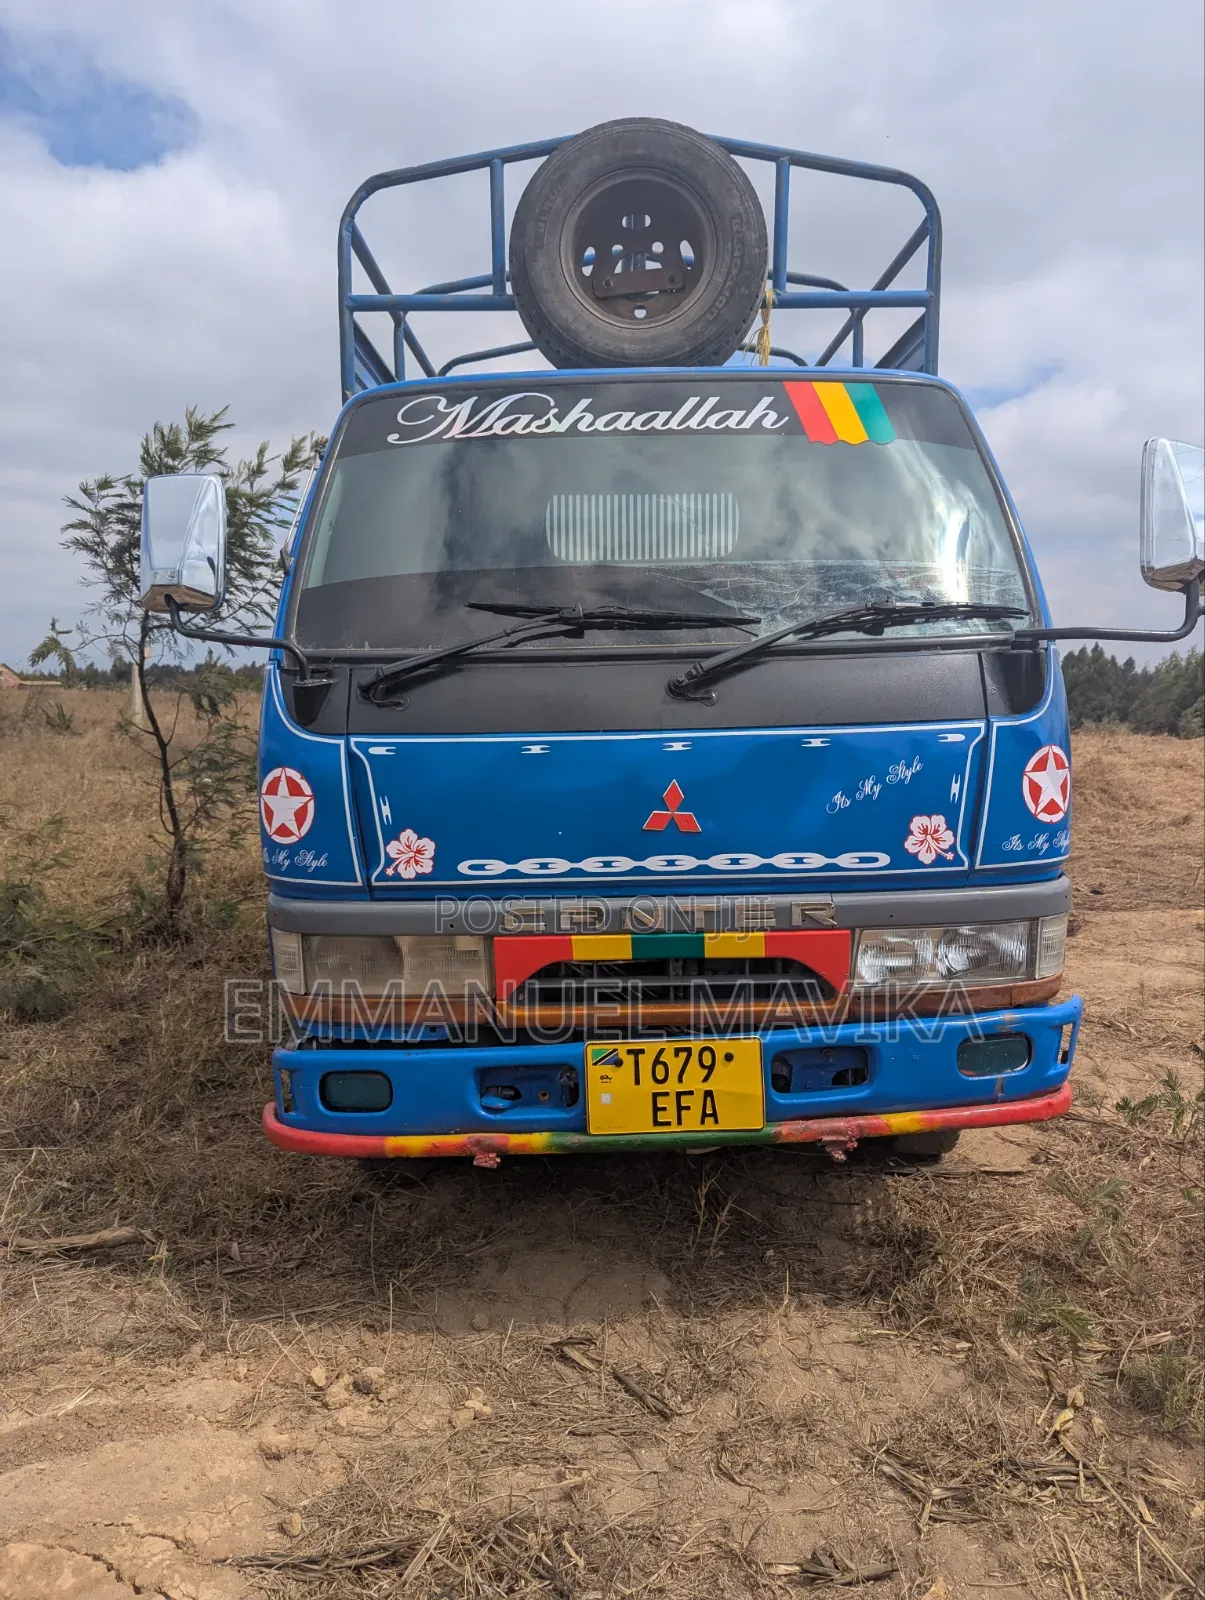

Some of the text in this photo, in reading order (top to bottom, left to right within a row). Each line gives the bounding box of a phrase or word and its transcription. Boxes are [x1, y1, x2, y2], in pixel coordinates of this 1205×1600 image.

[386, 391, 789, 444] Mashaallah
[826, 755, 923, 814] Its My Style
[272, 848, 291, 871] My
[294, 849, 328, 873] Style
[1001, 833, 1025, 851] Its
[1027, 832, 1050, 856] My
[626, 1045, 717, 1086] T679
[651, 1089, 720, 1127] EFA
